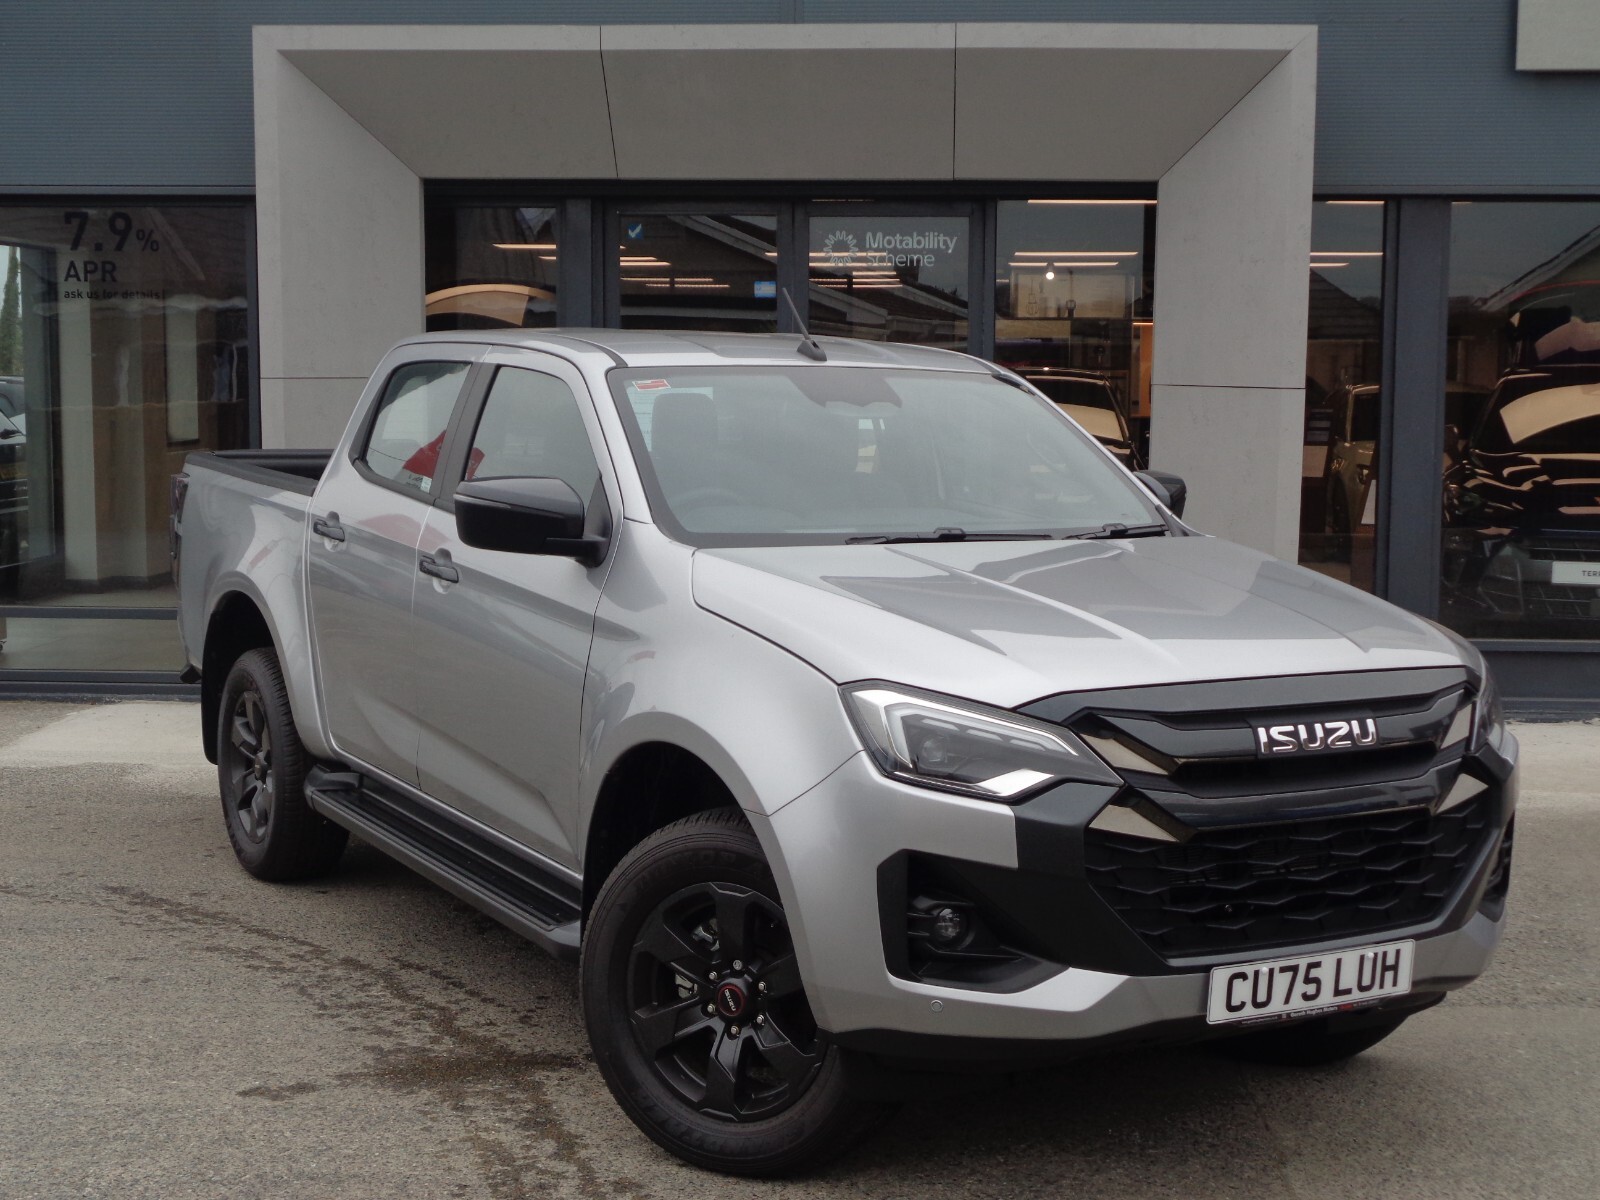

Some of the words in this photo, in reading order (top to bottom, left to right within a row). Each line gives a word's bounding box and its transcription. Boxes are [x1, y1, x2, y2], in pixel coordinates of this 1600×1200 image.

[64, 211, 159, 251] 7.9%
[866, 232, 957, 253] Motability
[866, 252, 935, 267] Scheme
[64, 261, 117, 282] APR
[64, 289, 83, 299] ask
[86, 290, 99, 299] us
[103, 289, 118, 299] for
[1257, 718, 1376, 754] ISUZU
[1225, 961, 1322, 1013] CU75
[1333, 948, 1401, 998] LUH
